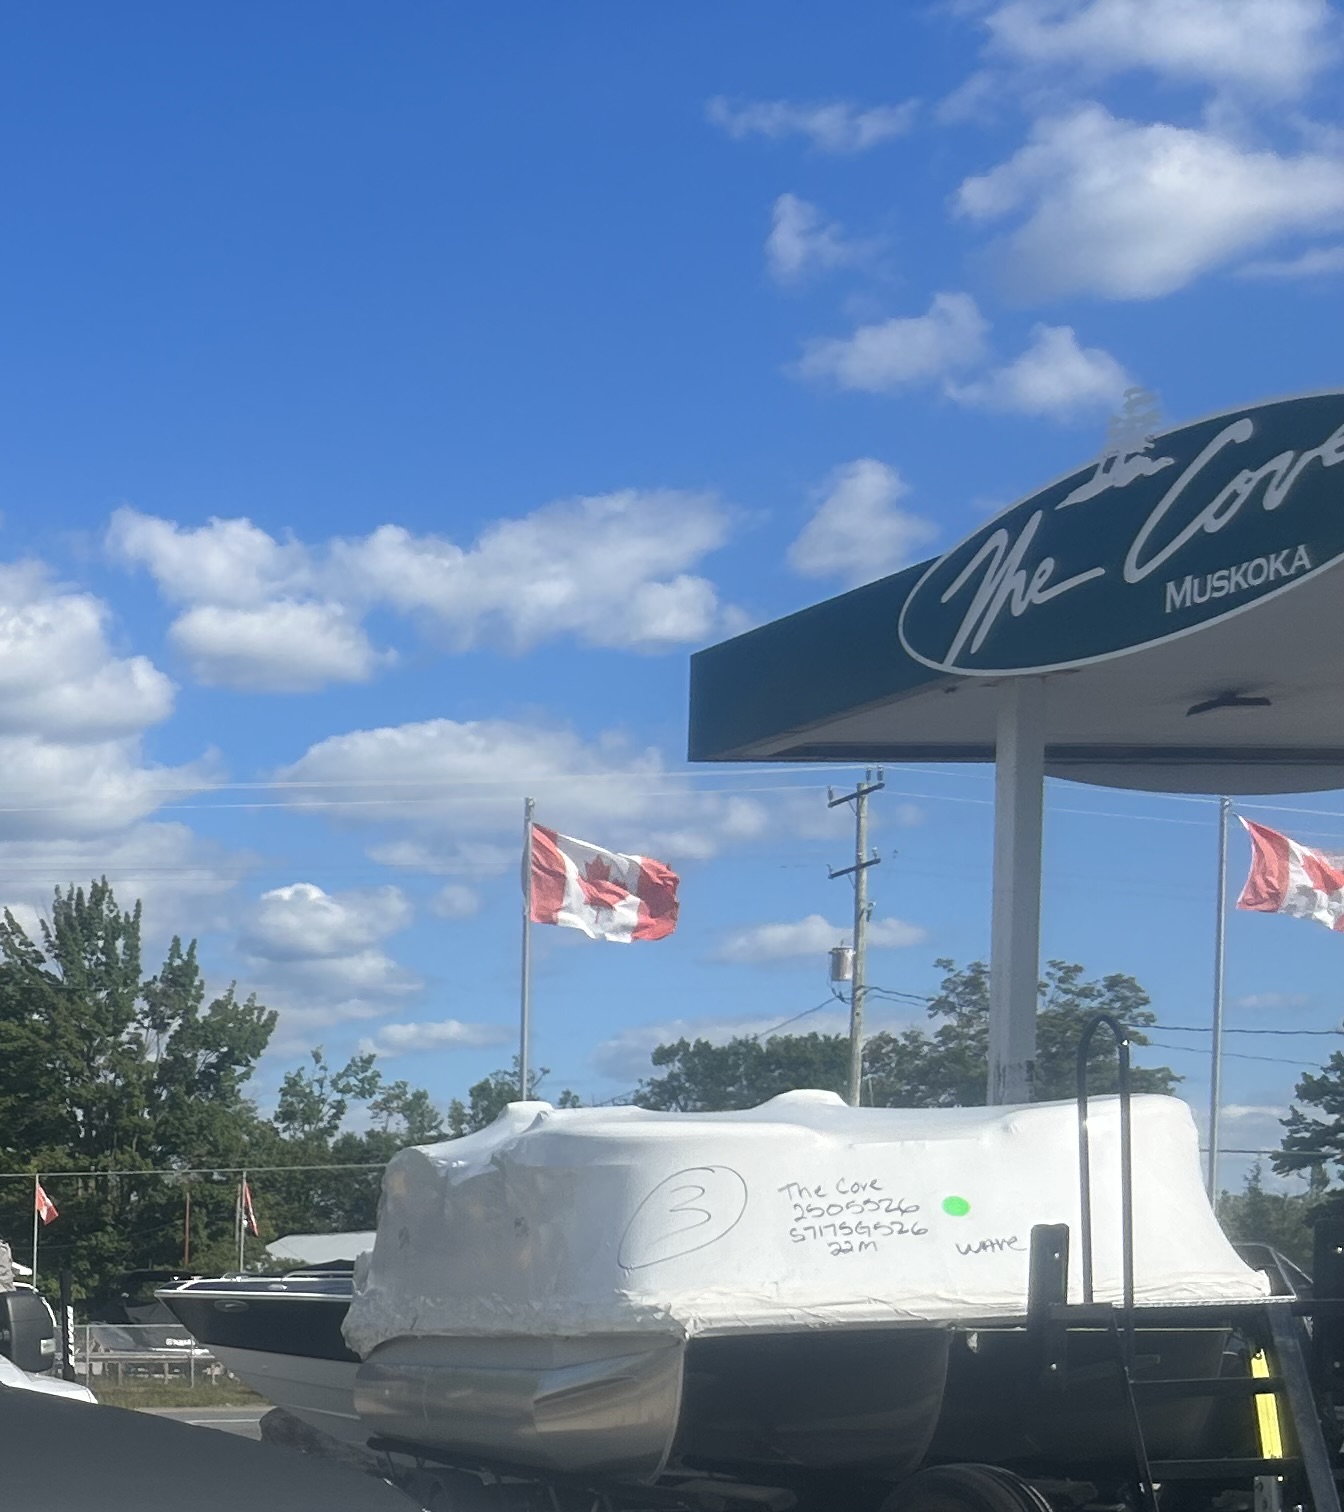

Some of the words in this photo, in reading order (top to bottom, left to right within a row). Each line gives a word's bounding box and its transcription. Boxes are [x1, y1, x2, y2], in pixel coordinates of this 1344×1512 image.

[941, 509, 1105, 667] The
[647, 1184, 712, 1247] 3
[778, 1181, 827, 1200] The
[836, 1177, 883, 1194] Cove
